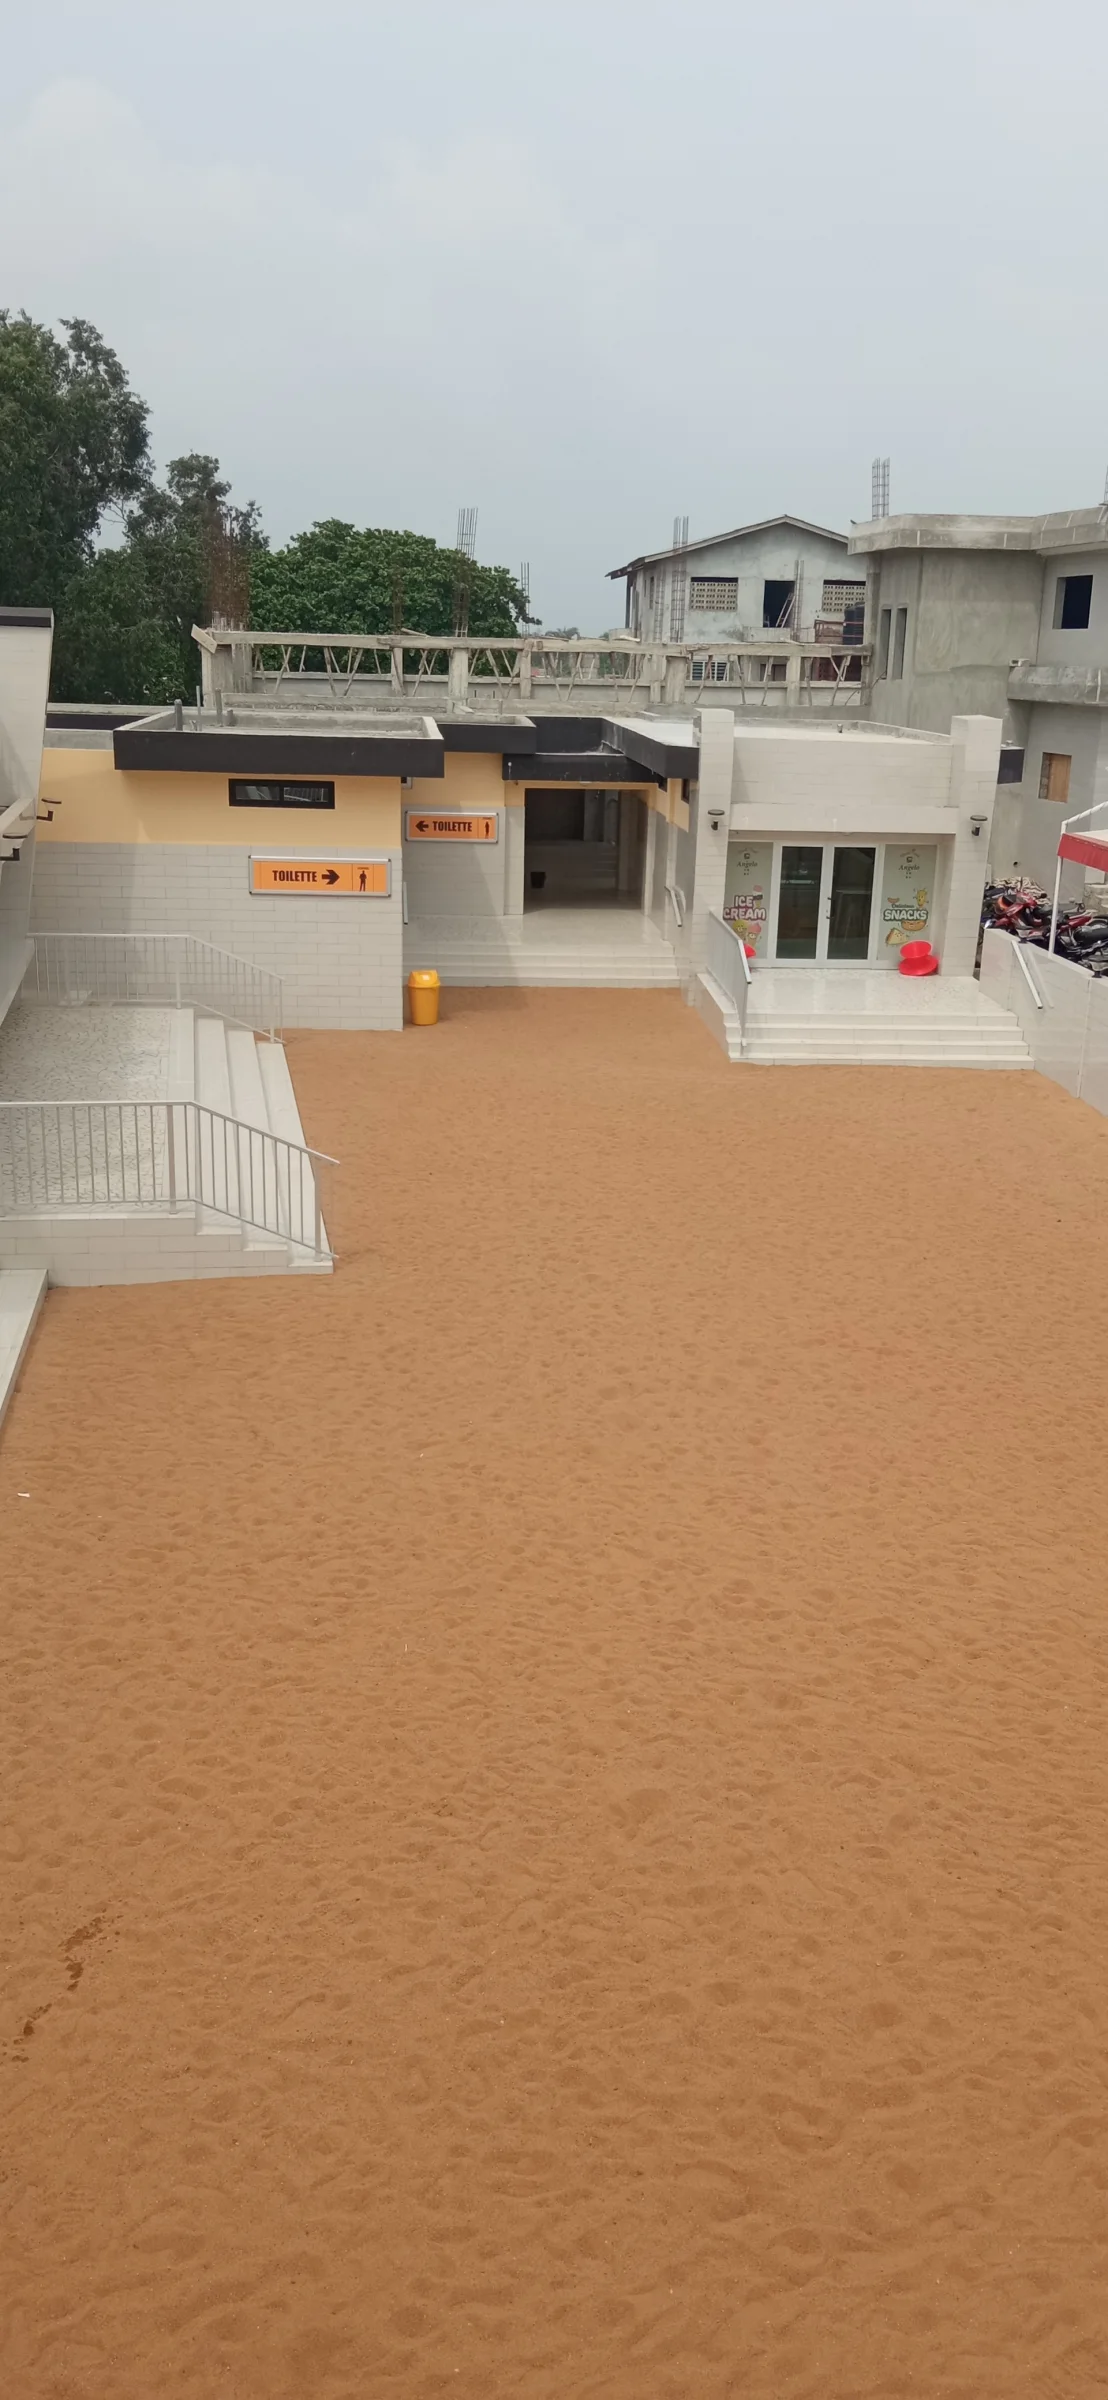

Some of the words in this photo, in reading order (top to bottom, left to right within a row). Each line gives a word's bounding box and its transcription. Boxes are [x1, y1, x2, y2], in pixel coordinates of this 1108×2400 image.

[432, 820, 472, 832] TOILETTE
[272, 869, 317, 882] TOILETTE
[734, 895, 754, 908] ICE
[723, 907, 767, 921] CREAM
[883, 909, 928, 921] SNACKS
